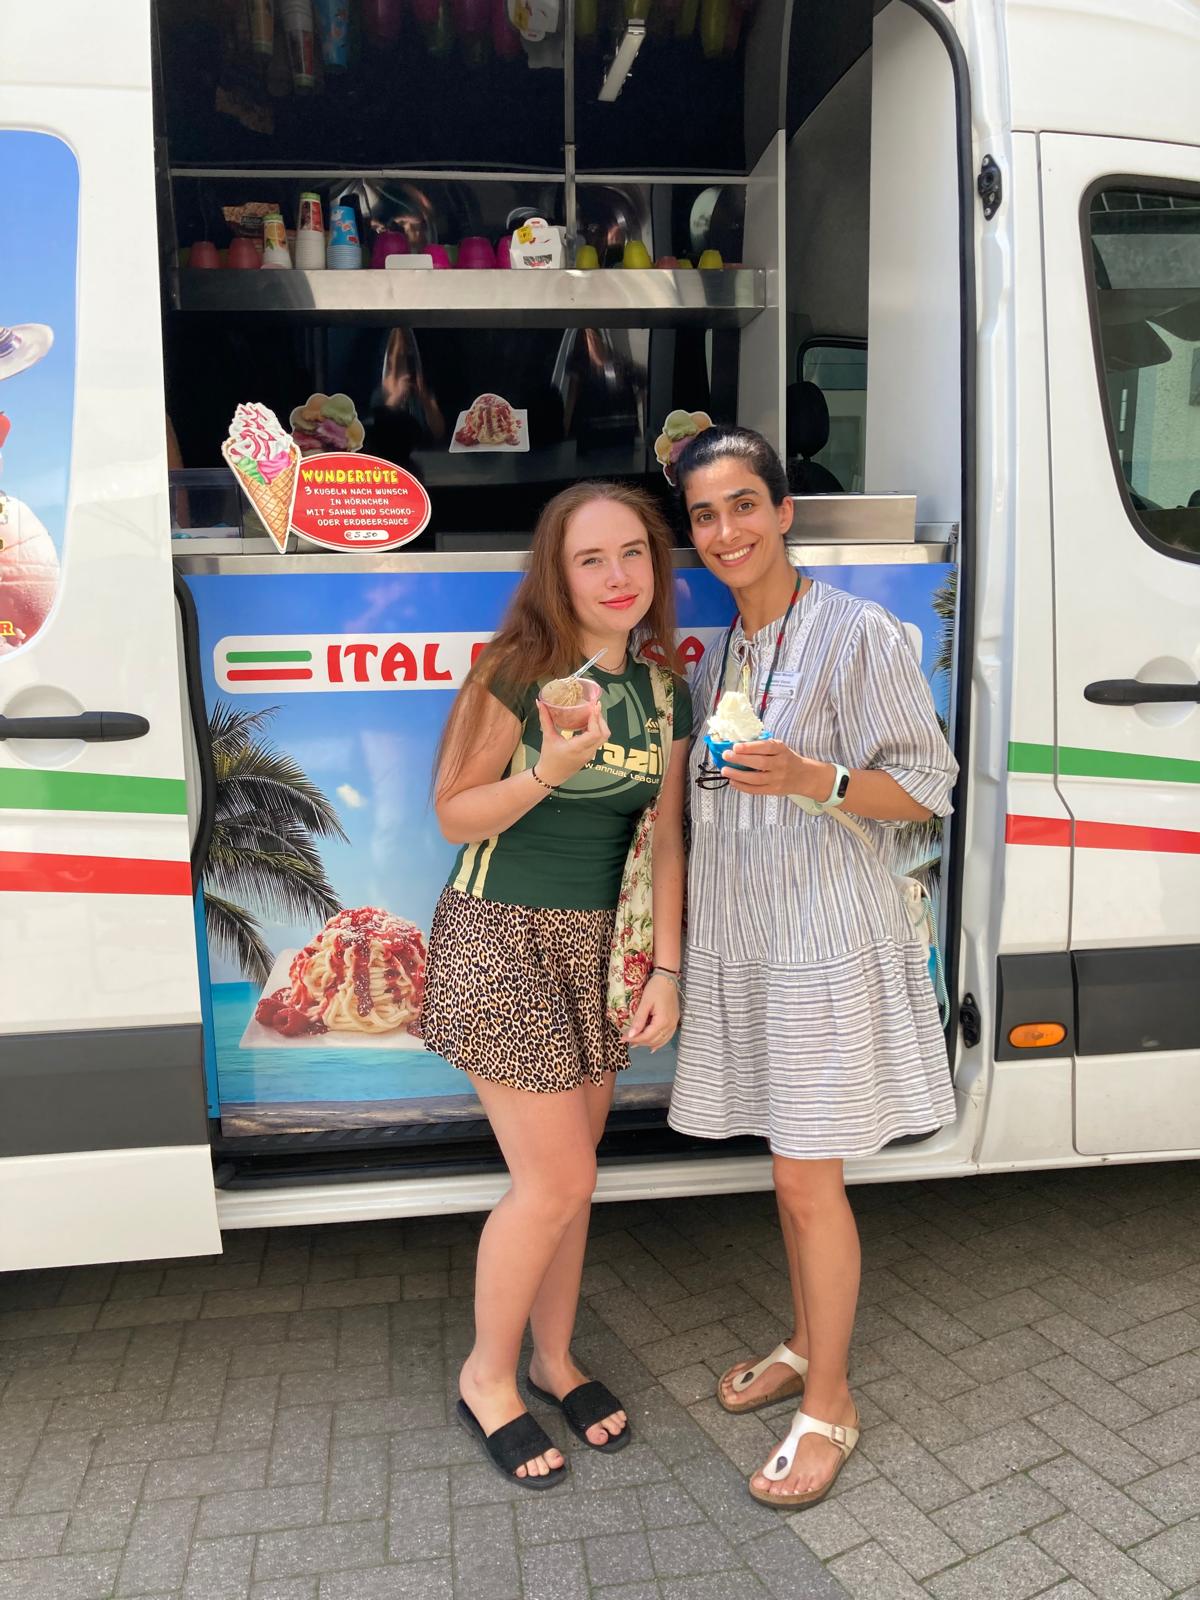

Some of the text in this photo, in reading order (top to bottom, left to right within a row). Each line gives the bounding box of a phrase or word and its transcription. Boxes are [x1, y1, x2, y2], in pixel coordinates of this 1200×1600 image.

[301, 466, 398, 484] WUNDERTÜTE
[305, 486, 312, 495] 3
[344, 497, 389, 505] HÖRNCHEN
[343, 518, 409, 526] ERDBEERSAUCE
[327, 642, 453, 683] ITAL
